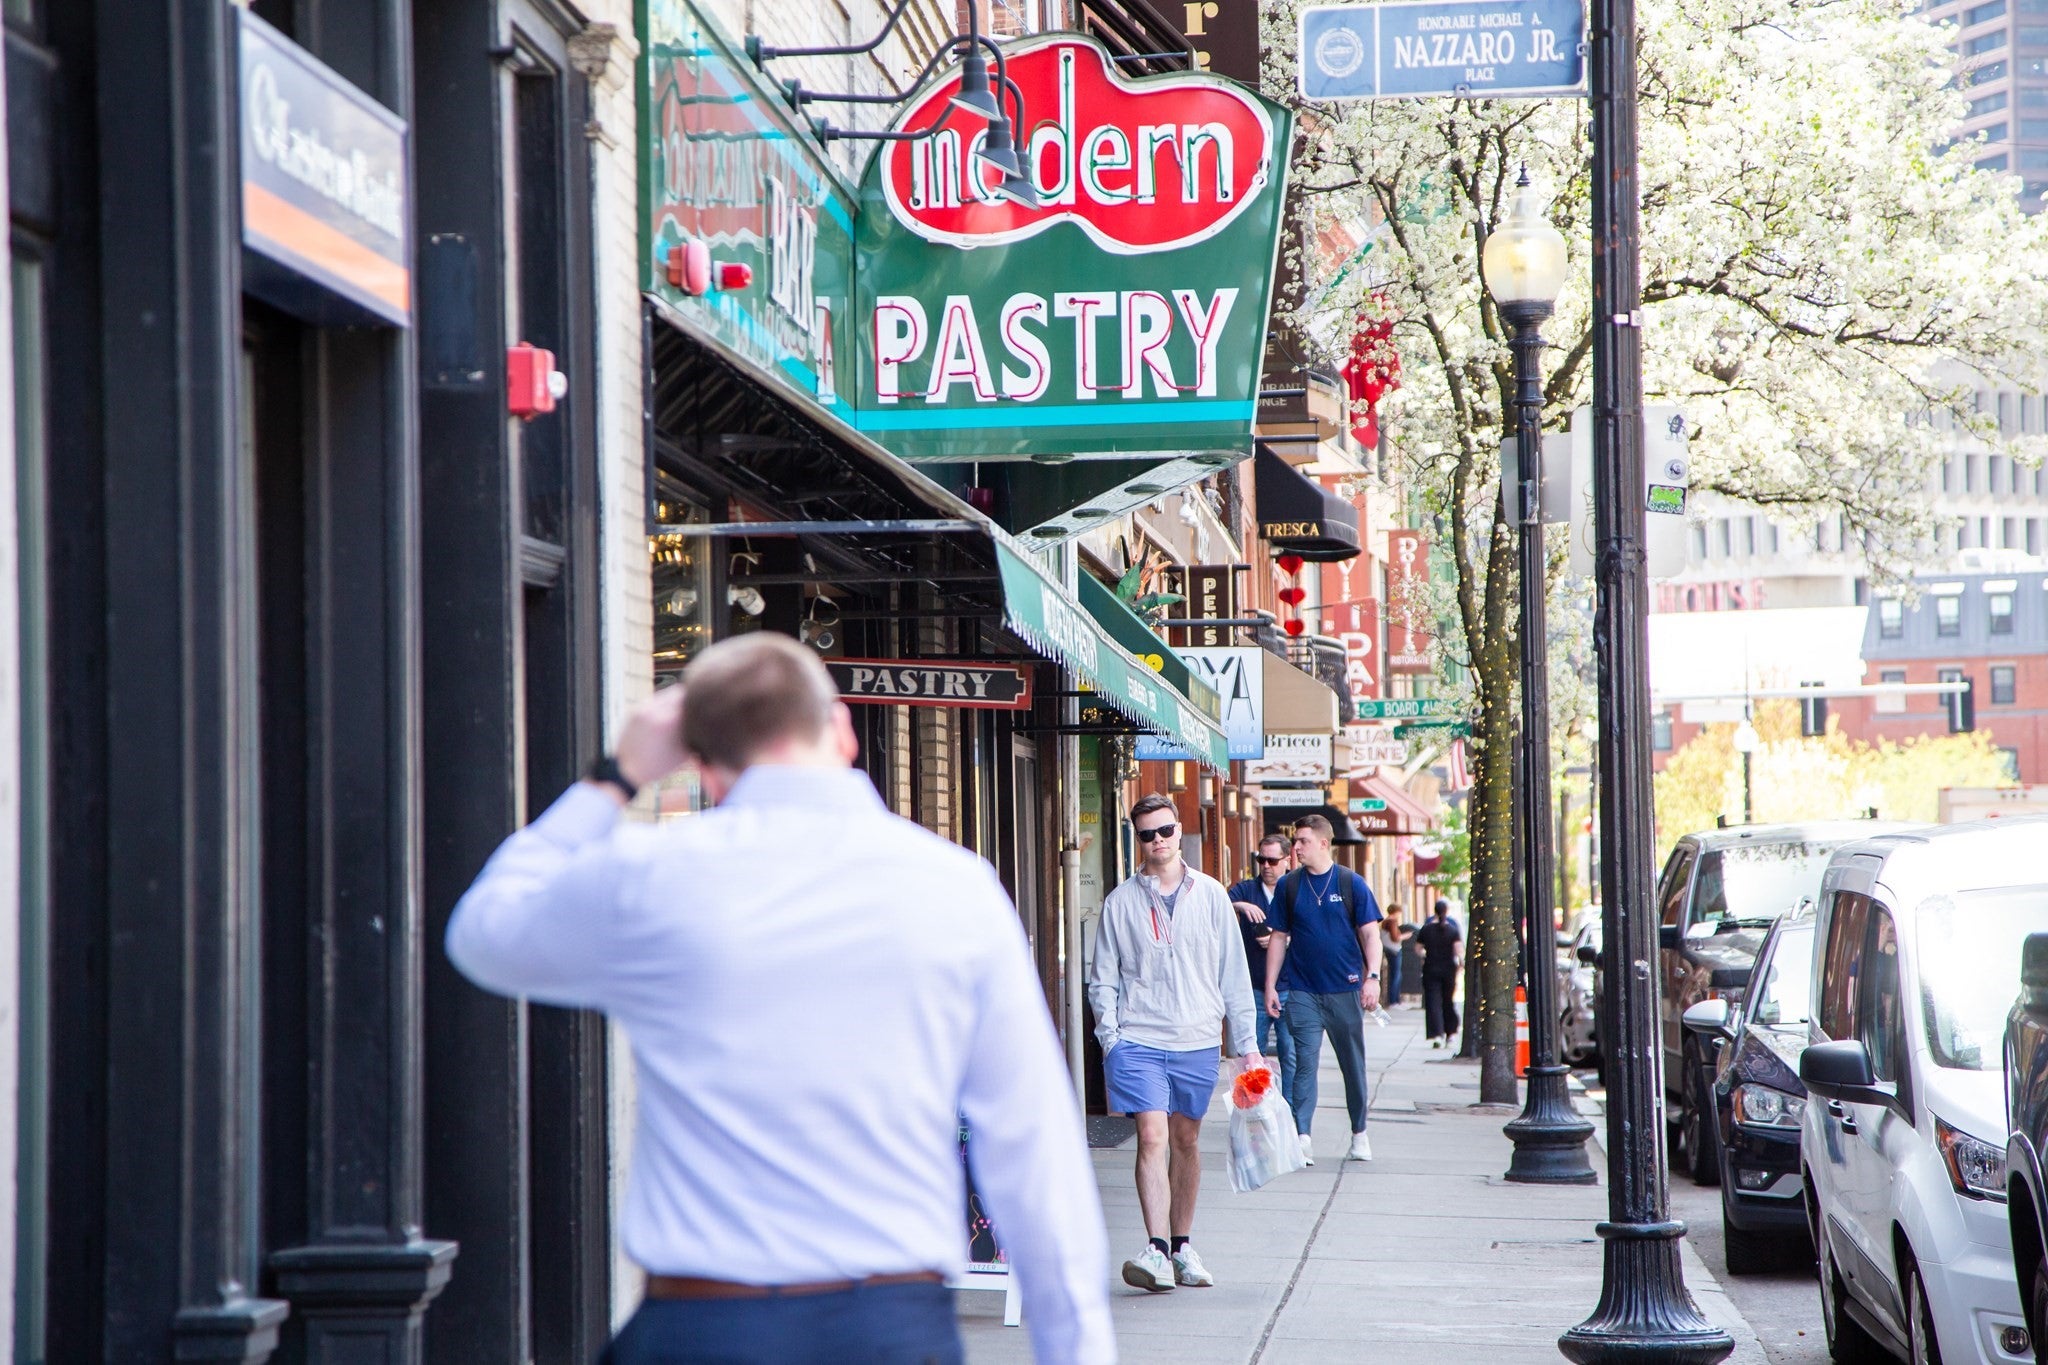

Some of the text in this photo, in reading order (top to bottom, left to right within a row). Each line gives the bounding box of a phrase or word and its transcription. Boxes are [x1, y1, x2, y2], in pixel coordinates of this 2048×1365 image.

[1418, 11, 1543, 31] HONORABLE MICHAEL A.
[1394, 28, 1566, 69] NAZZARO JR.
[1465, 67, 1496, 82] PLACE
[910, 47, 1235, 211] modern
[768, 174, 817, 338] BAR
[874, 287, 1240, 405] PASTRY
[1264, 522, 1321, 537] TRESCA
[850, 667, 993, 698] PASTRY
[1384, 701, 1420, 717] BOARD
[1264, 734, 1322, 748] Bricco
[1361, 815, 1389, 829] Vita
